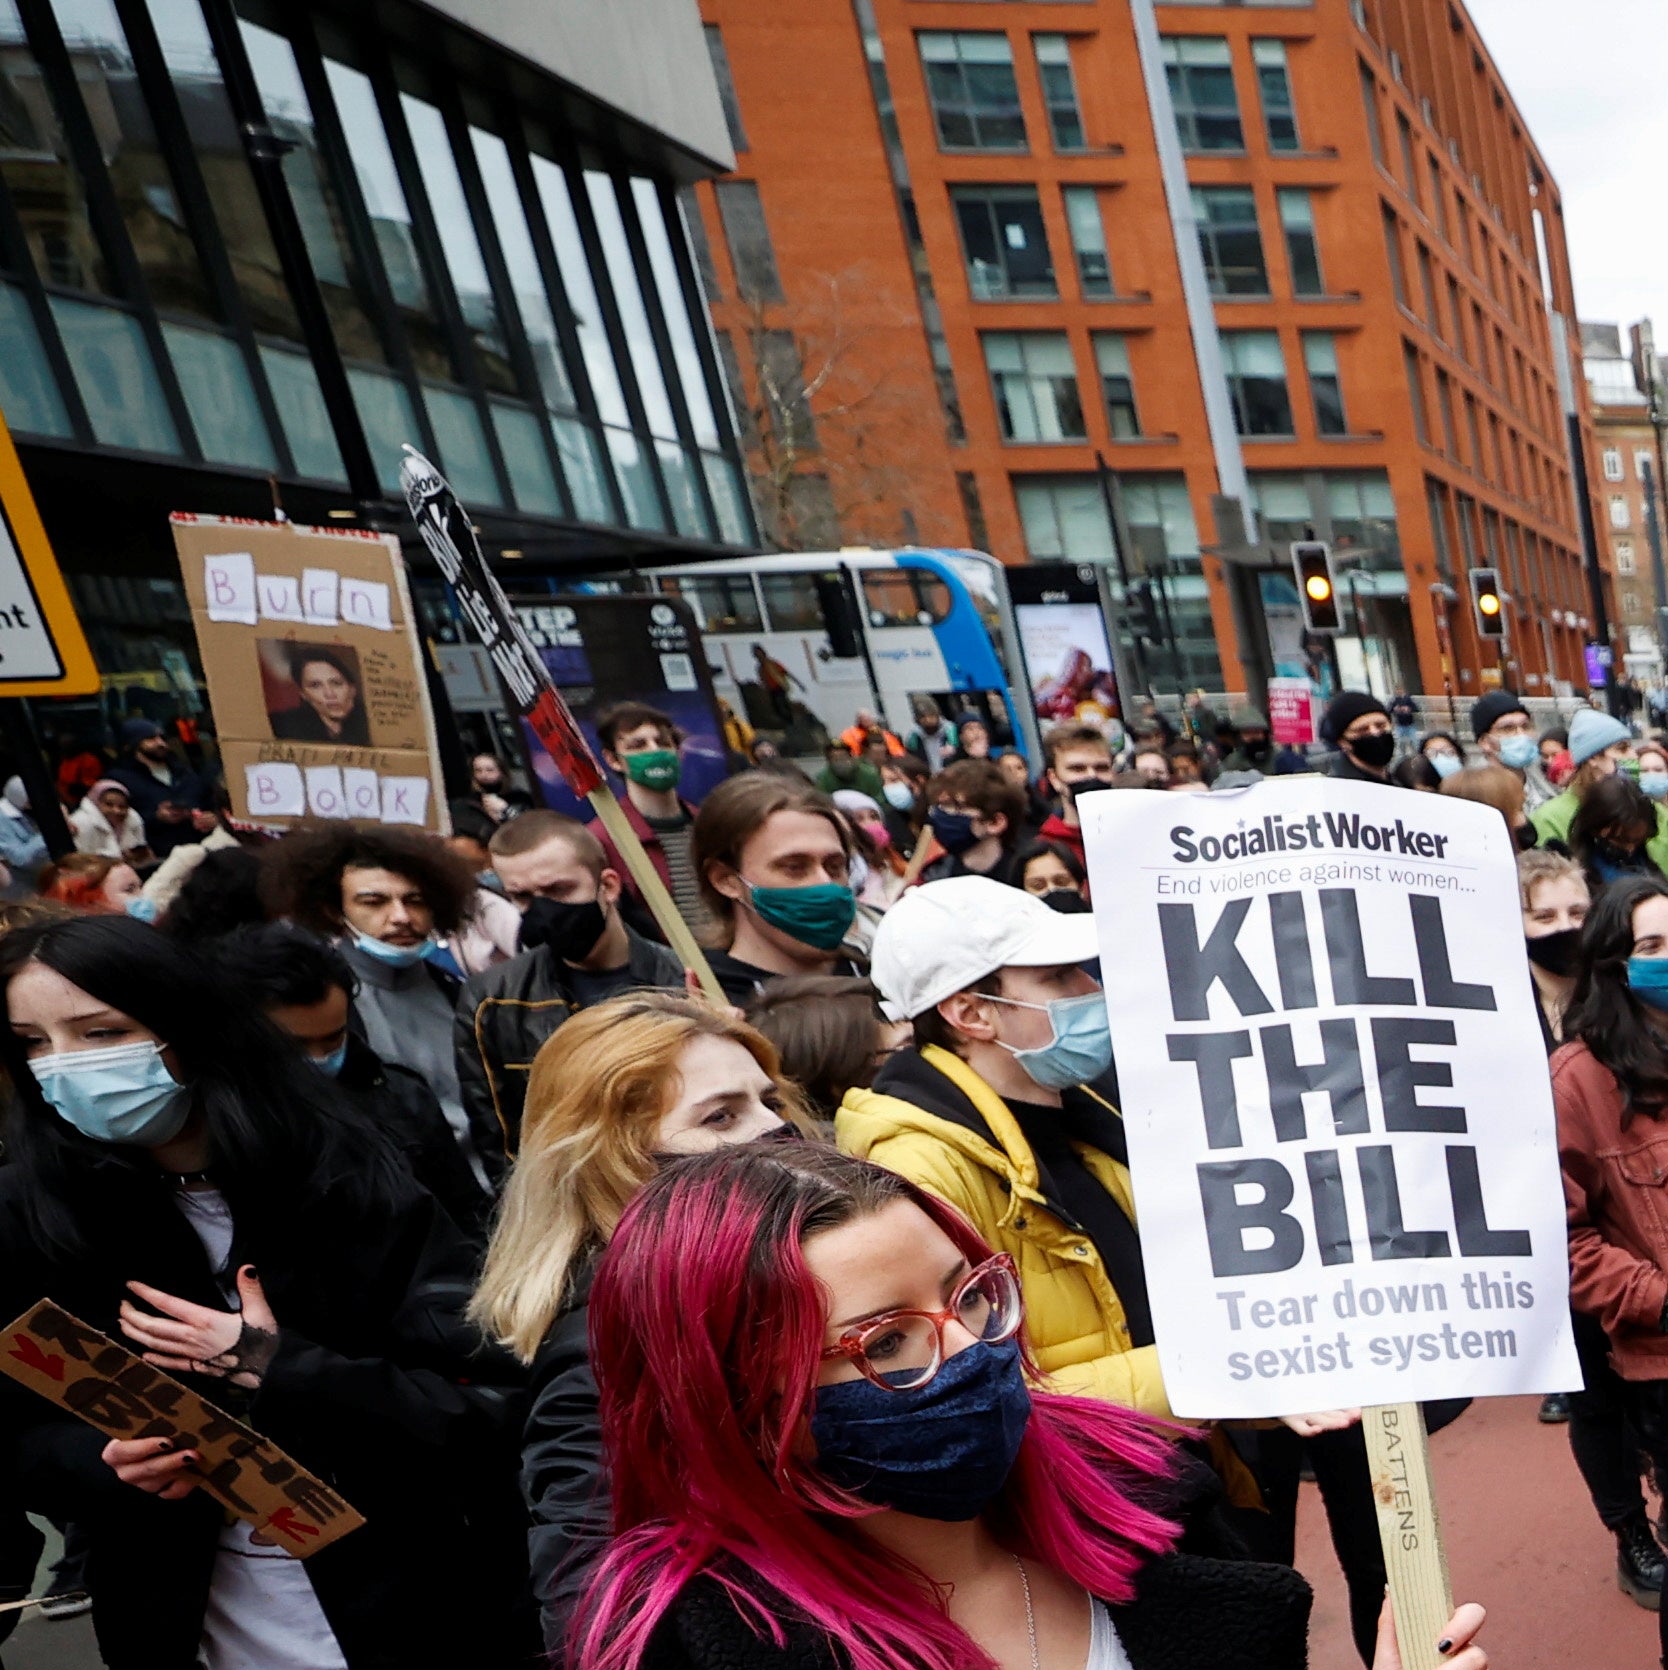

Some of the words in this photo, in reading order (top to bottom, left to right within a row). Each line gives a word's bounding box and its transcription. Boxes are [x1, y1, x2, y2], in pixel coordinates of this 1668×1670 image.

[210, 569, 376, 619] Burn
[1157, 872, 1201, 896] End
[1209, 865, 1292, 894] violence
[1299, 861, 1383, 884] against
[1387, 868, 1477, 893] women...
[1169, 813, 1324, 864] Socialist
[1323, 811, 1449, 860] Worker
[1157, 887, 1499, 1023] KILL
[1165, 1016, 1469, 1151] THE
[1195, 1145, 1534, 1278] BILL
[1216, 1290, 1319, 1332] Tear
[1333, 1277, 1448, 1322] down
[1460, 1270, 1536, 1312] this
[1227, 1338, 1354, 1383] sexist
[1368, 1325, 1519, 1373] system
[27, 1306, 186, 1417] KILL
[199, 1404, 348, 1527] THE
[1380, 1408, 1420, 1553] BATTENS
